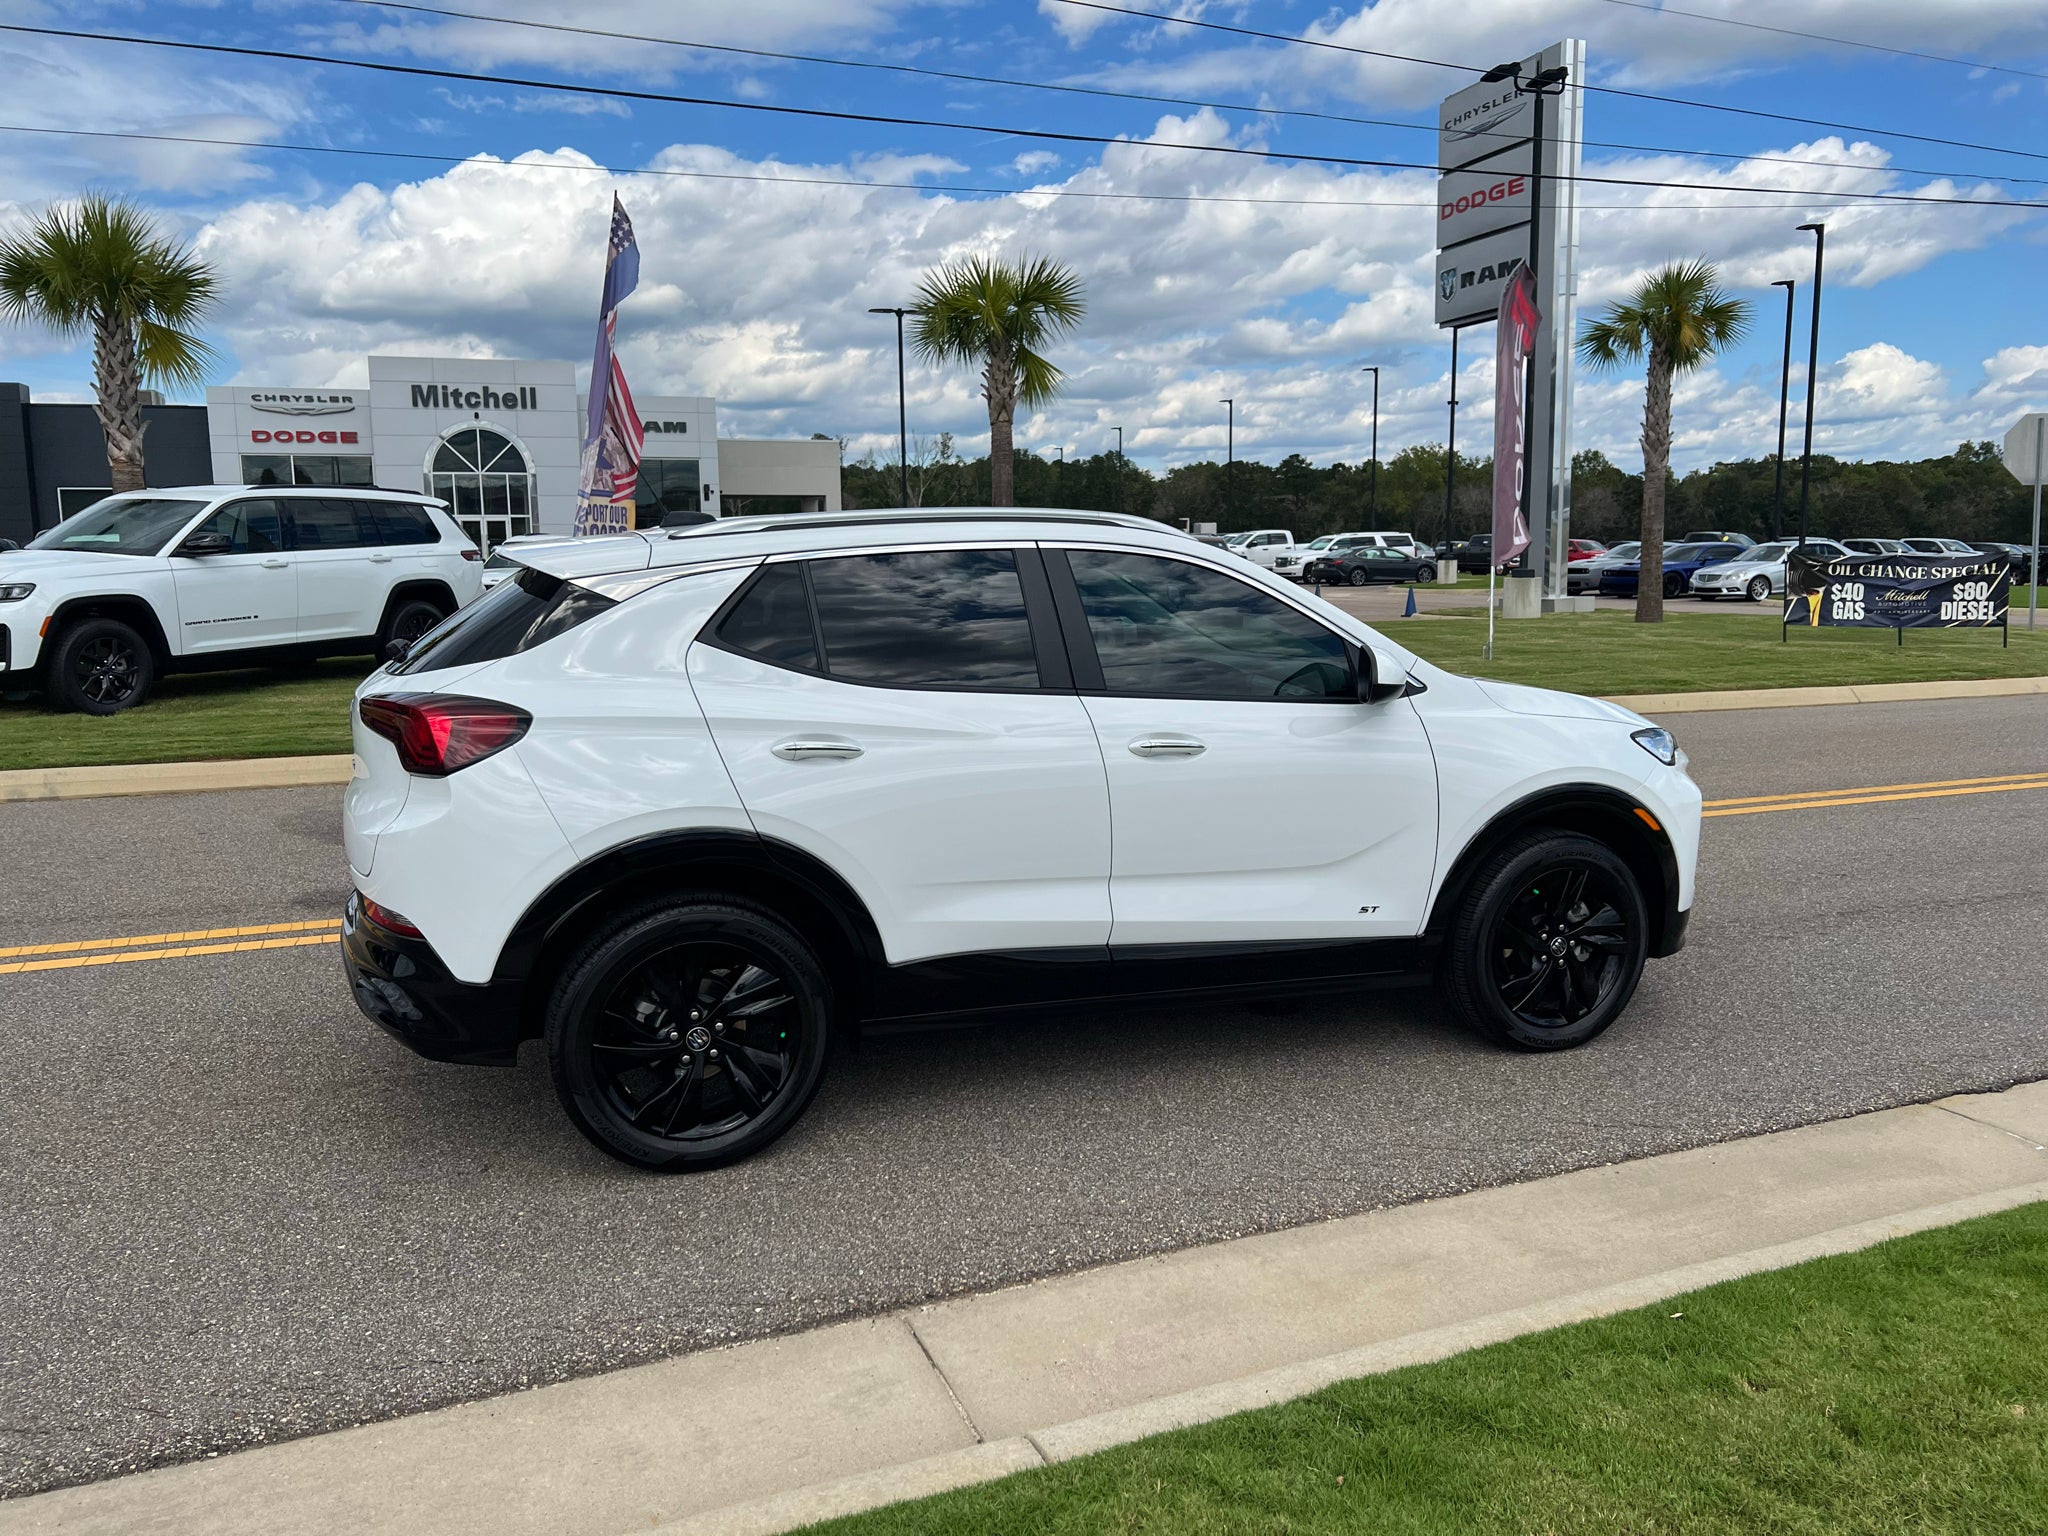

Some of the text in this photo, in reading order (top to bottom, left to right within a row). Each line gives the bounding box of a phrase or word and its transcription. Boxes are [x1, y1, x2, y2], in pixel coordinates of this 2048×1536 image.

[1444, 89, 1525, 130] CHRYSLER
[1440, 176, 1525, 221] DODGE
[1460, 257, 1523, 289] RAM
[251, 394, 354, 404] CHRYSLER
[410, 384, 537, 410] Mitchell
[643, 420, 687, 434] AM
[251, 430, 359, 444] DODGE
[609, 505, 628, 525] OUR
[1828, 562, 2000, 579] OIL CHANGE SPECIAL
[1831, 582, 1864, 601] $40
[1875, 589, 1931, 601] Mitchell
[1952, 581, 1987, 601] $80
[1832, 601, 1865, 620] GAS
[1940, 601, 1997, 620] DIESEL
[1358, 905, 1380, 914] ST
